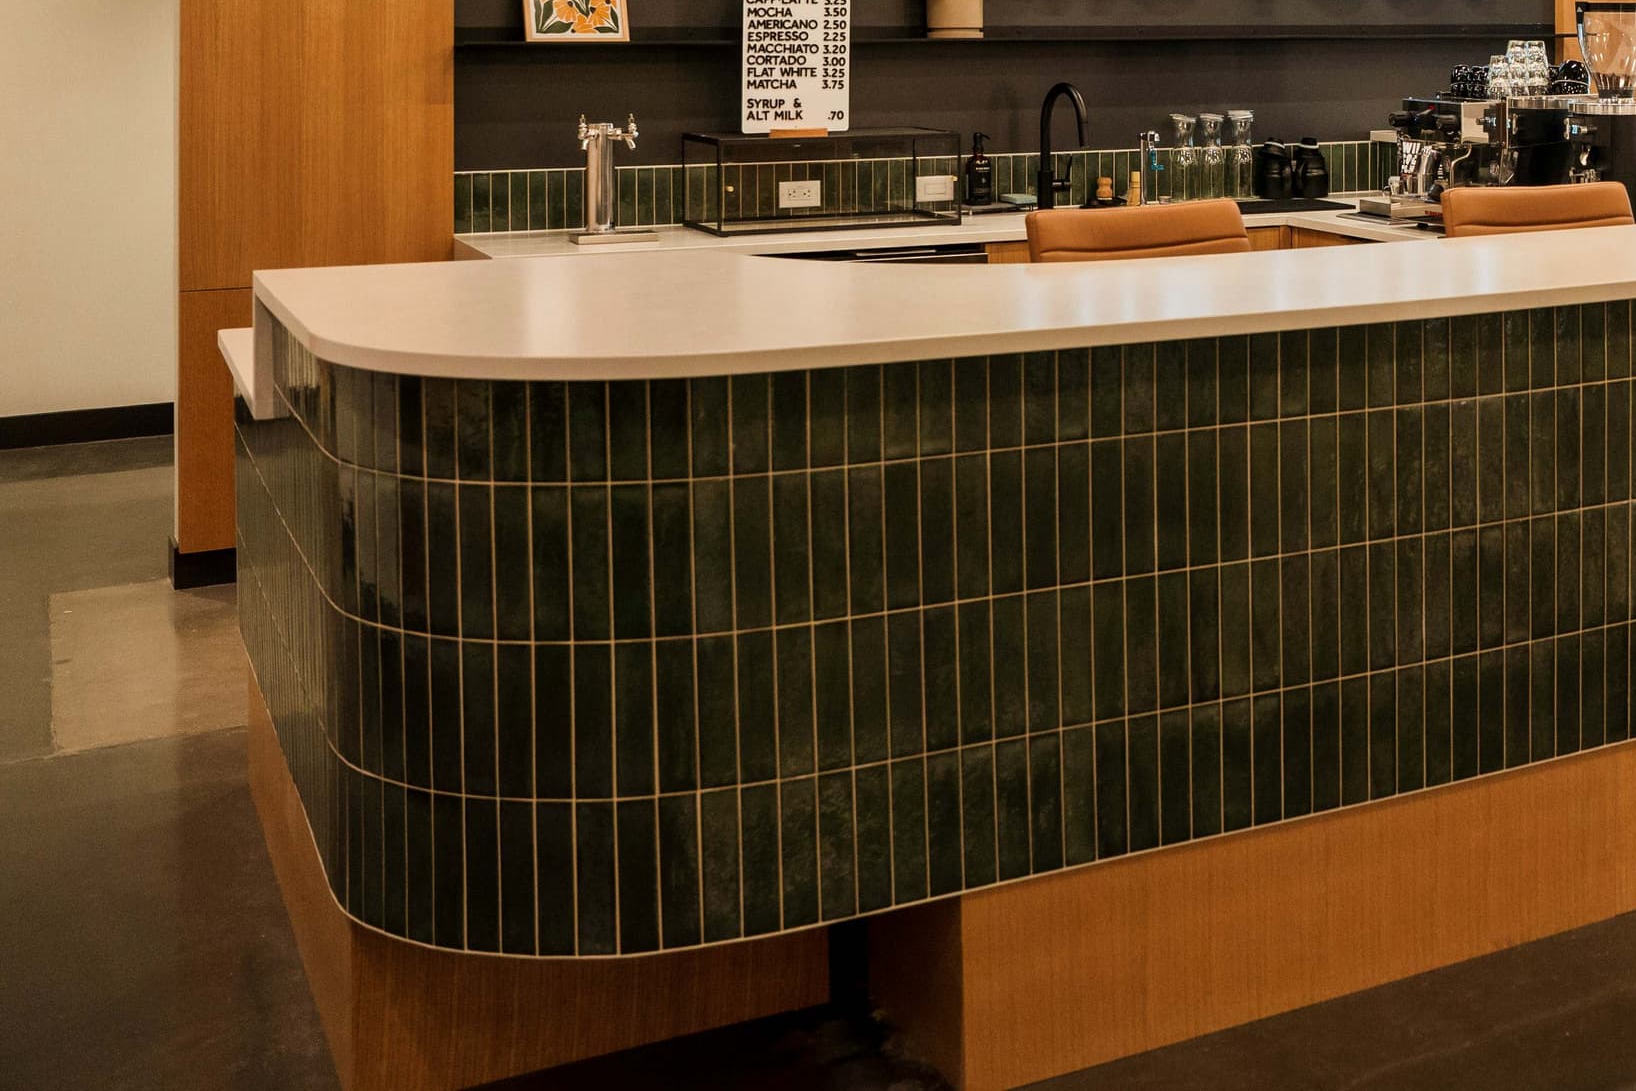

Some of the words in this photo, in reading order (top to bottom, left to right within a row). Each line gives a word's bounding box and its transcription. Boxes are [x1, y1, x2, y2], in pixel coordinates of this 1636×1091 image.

[747, 7, 792, 18] MOCHA
[824, 7, 847, 17] 3.50
[748, 19, 818, 30] AMERICANO
[824, 20, 847, 30] 2.50
[748, 31, 808, 42] ESPRESSO
[823, 32, 846, 42] 2.25
[747, 43, 819, 54] MACCHIATO
[823, 45, 846, 54] 3.20
[747, 55, 806, 65] CORTADO
[823, 57, 846, 66] 3.00
[747, 67, 776, 77] FLAT
[780, 67, 817, 77] WHITE
[822, 68, 845, 78] 3.25
[747, 79, 797, 89] MATCHA
[822, 80, 844, 89] 3.75
[747, 98, 785, 109] SYRUP
[793, 98, 801, 108] &
[747, 110, 770, 121] ALT
[774, 110, 803, 121] MILK
